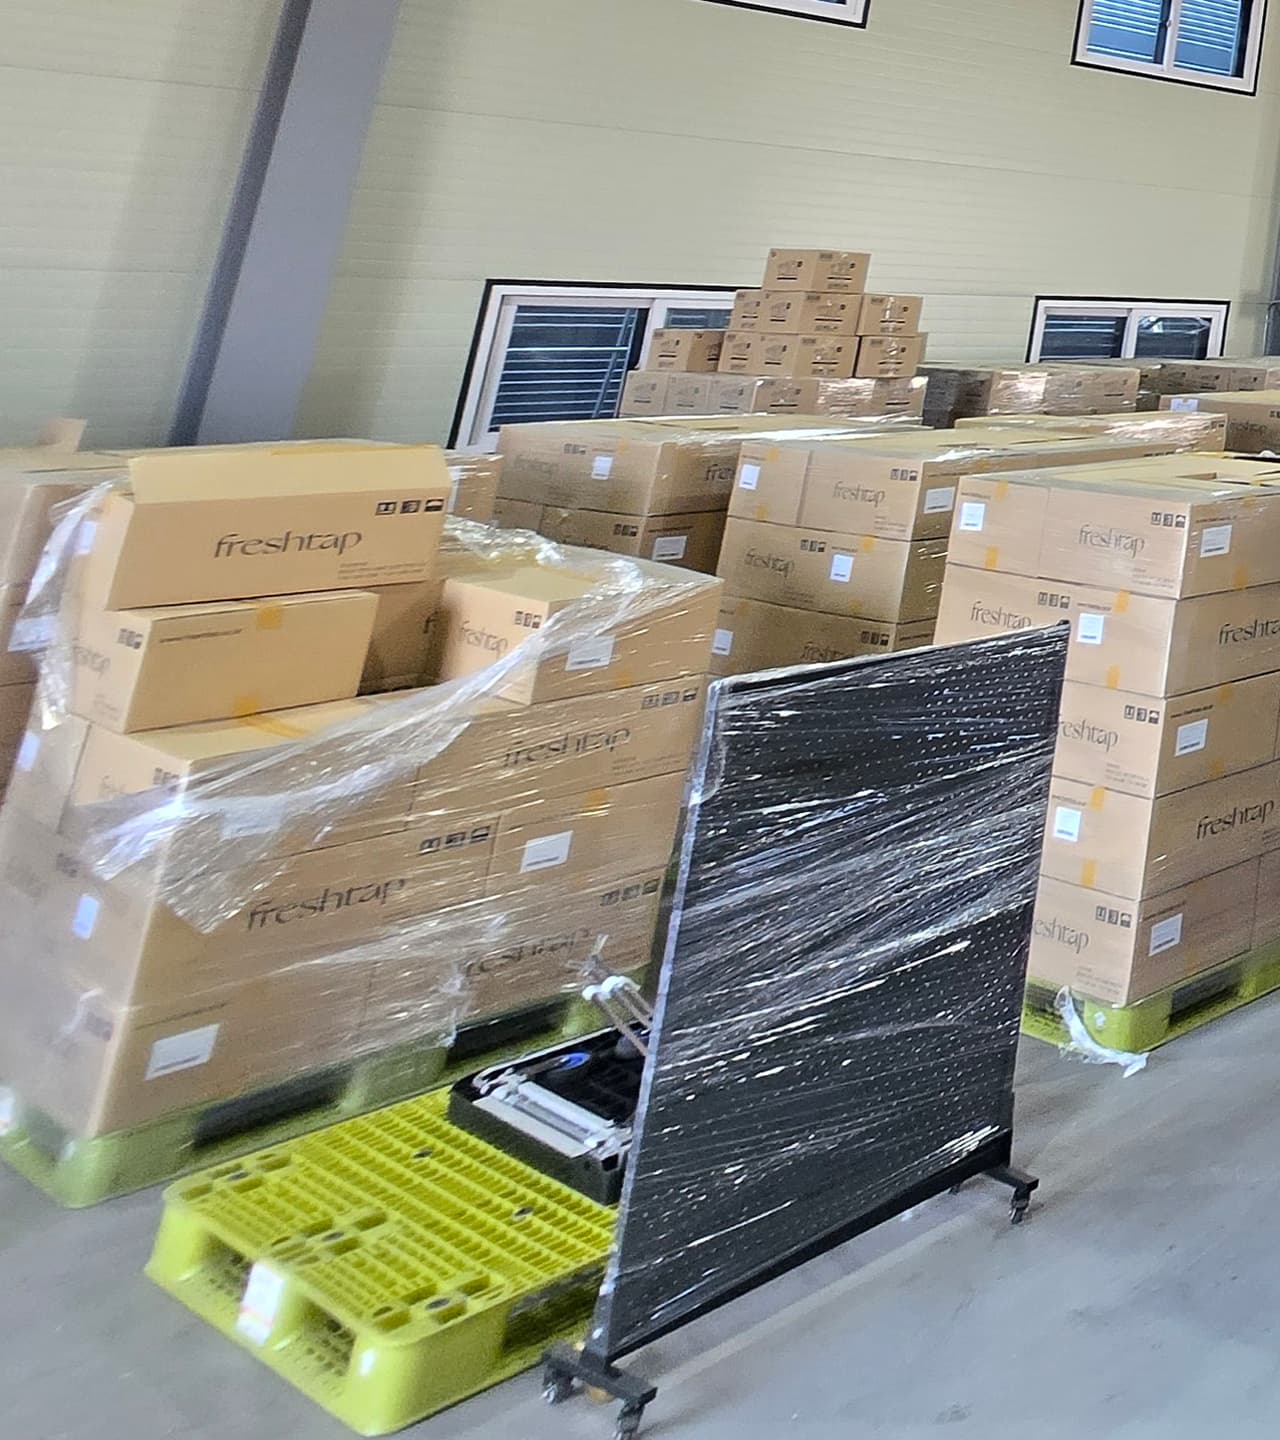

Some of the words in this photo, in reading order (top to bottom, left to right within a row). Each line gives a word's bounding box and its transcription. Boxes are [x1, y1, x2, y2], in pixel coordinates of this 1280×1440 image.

[832, 481, 886, 507] freshtap
[213, 530, 362, 558] freshtap
[1079, 524, 1145, 558] freshtap
[744, 548, 795, 577] freshtap
[970, 601, 1032, 628] freshtap
[1060, 718, 1119, 752] eshtap
[1197, 800, 1275, 840] freshtap
[247, 878, 406, 931] freshtap
[1033, 916, 1089, 954] eshtap
